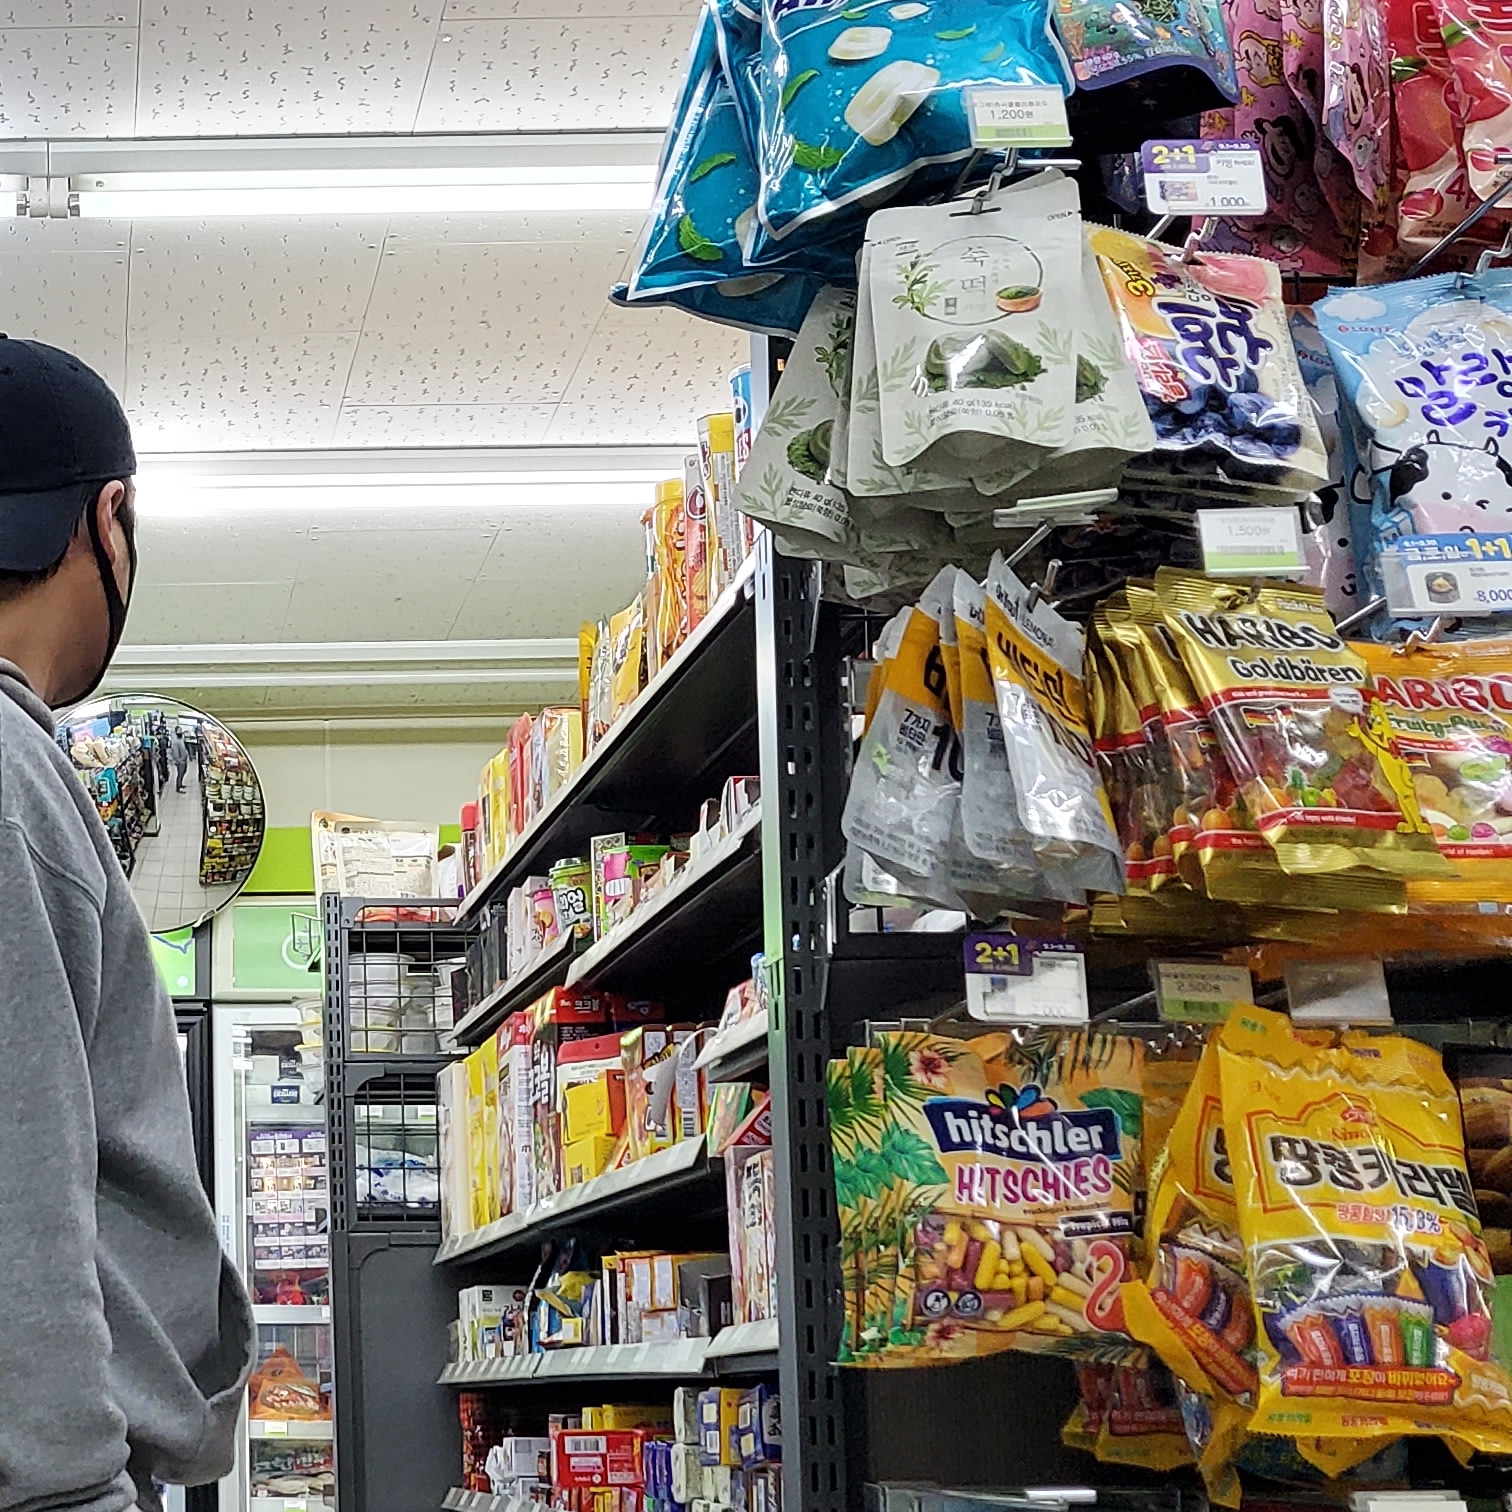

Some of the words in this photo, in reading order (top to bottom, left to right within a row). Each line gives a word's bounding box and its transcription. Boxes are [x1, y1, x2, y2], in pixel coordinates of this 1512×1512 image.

[990, 109, 1034, 119] 1,200원
[1152, 145, 1196, 165] 2+1
[1047, 212, 1067, 222] OPEN
[1466, 538, 1512, 561] 1+1
[1183, 610, 1345, 650] HARIBO
[1229, 655, 1363, 684] Goldbären
[976, 942, 1019, 965] 2+1
[947, 1111, 1105, 1154] hitschler
[957, 1158, 1112, 1205] HITSCHIES
[1269, 1134, 1479, 1218] 땅콩카라멜
